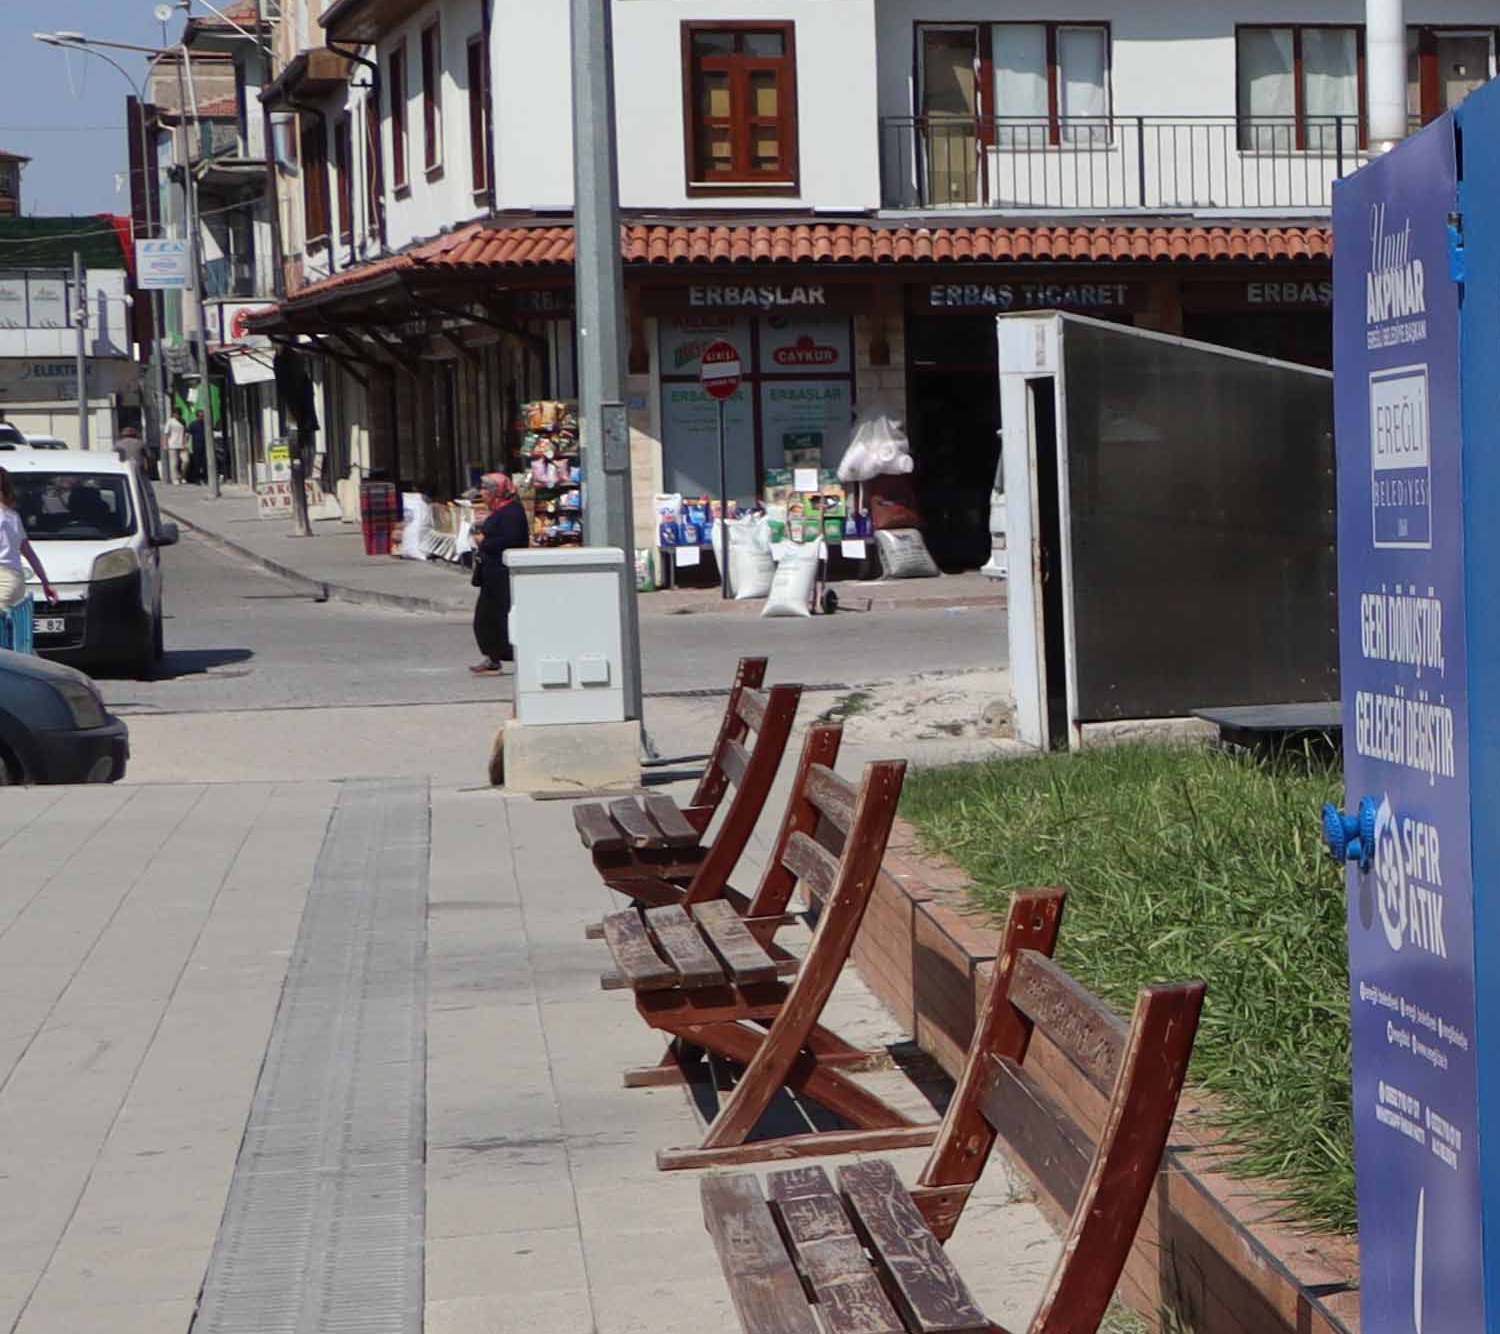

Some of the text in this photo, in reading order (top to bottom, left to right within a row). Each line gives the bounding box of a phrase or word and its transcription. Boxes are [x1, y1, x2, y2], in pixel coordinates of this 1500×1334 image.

[688, 285, 825, 310] ERBAŞLAR
[1360, 583, 1387, 661] GERİ
[1403, 817, 1442, 886] SIFIR
[1409, 883, 1447, 959] ATIK
